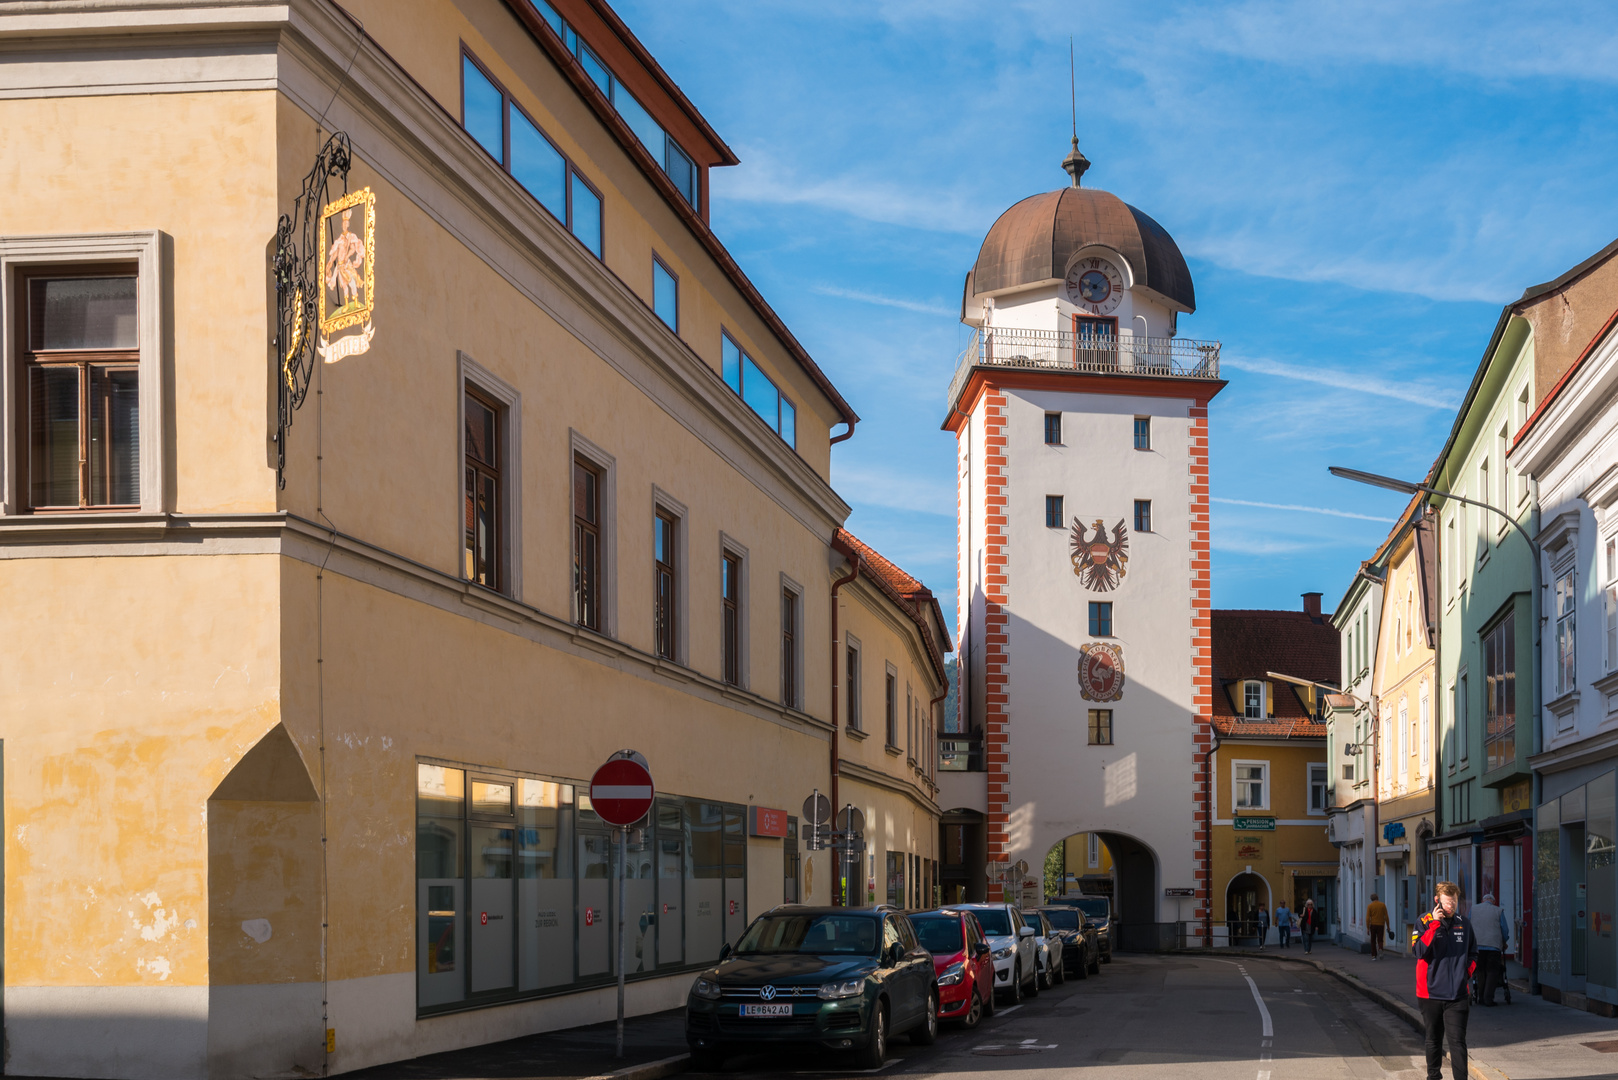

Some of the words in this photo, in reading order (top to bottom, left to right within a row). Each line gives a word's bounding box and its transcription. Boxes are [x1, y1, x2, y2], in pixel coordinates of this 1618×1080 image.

[1089, 260, 1100, 269] XII
[1068, 280, 1078, 289] IX
[1112, 284, 1121, 292] III
[332, 336, 363, 362] HOTEL
[1087, 646, 1116, 658] LEOBEN
[746, 1006, 756, 1014] LE
[762, 1006, 777, 1014] 642
